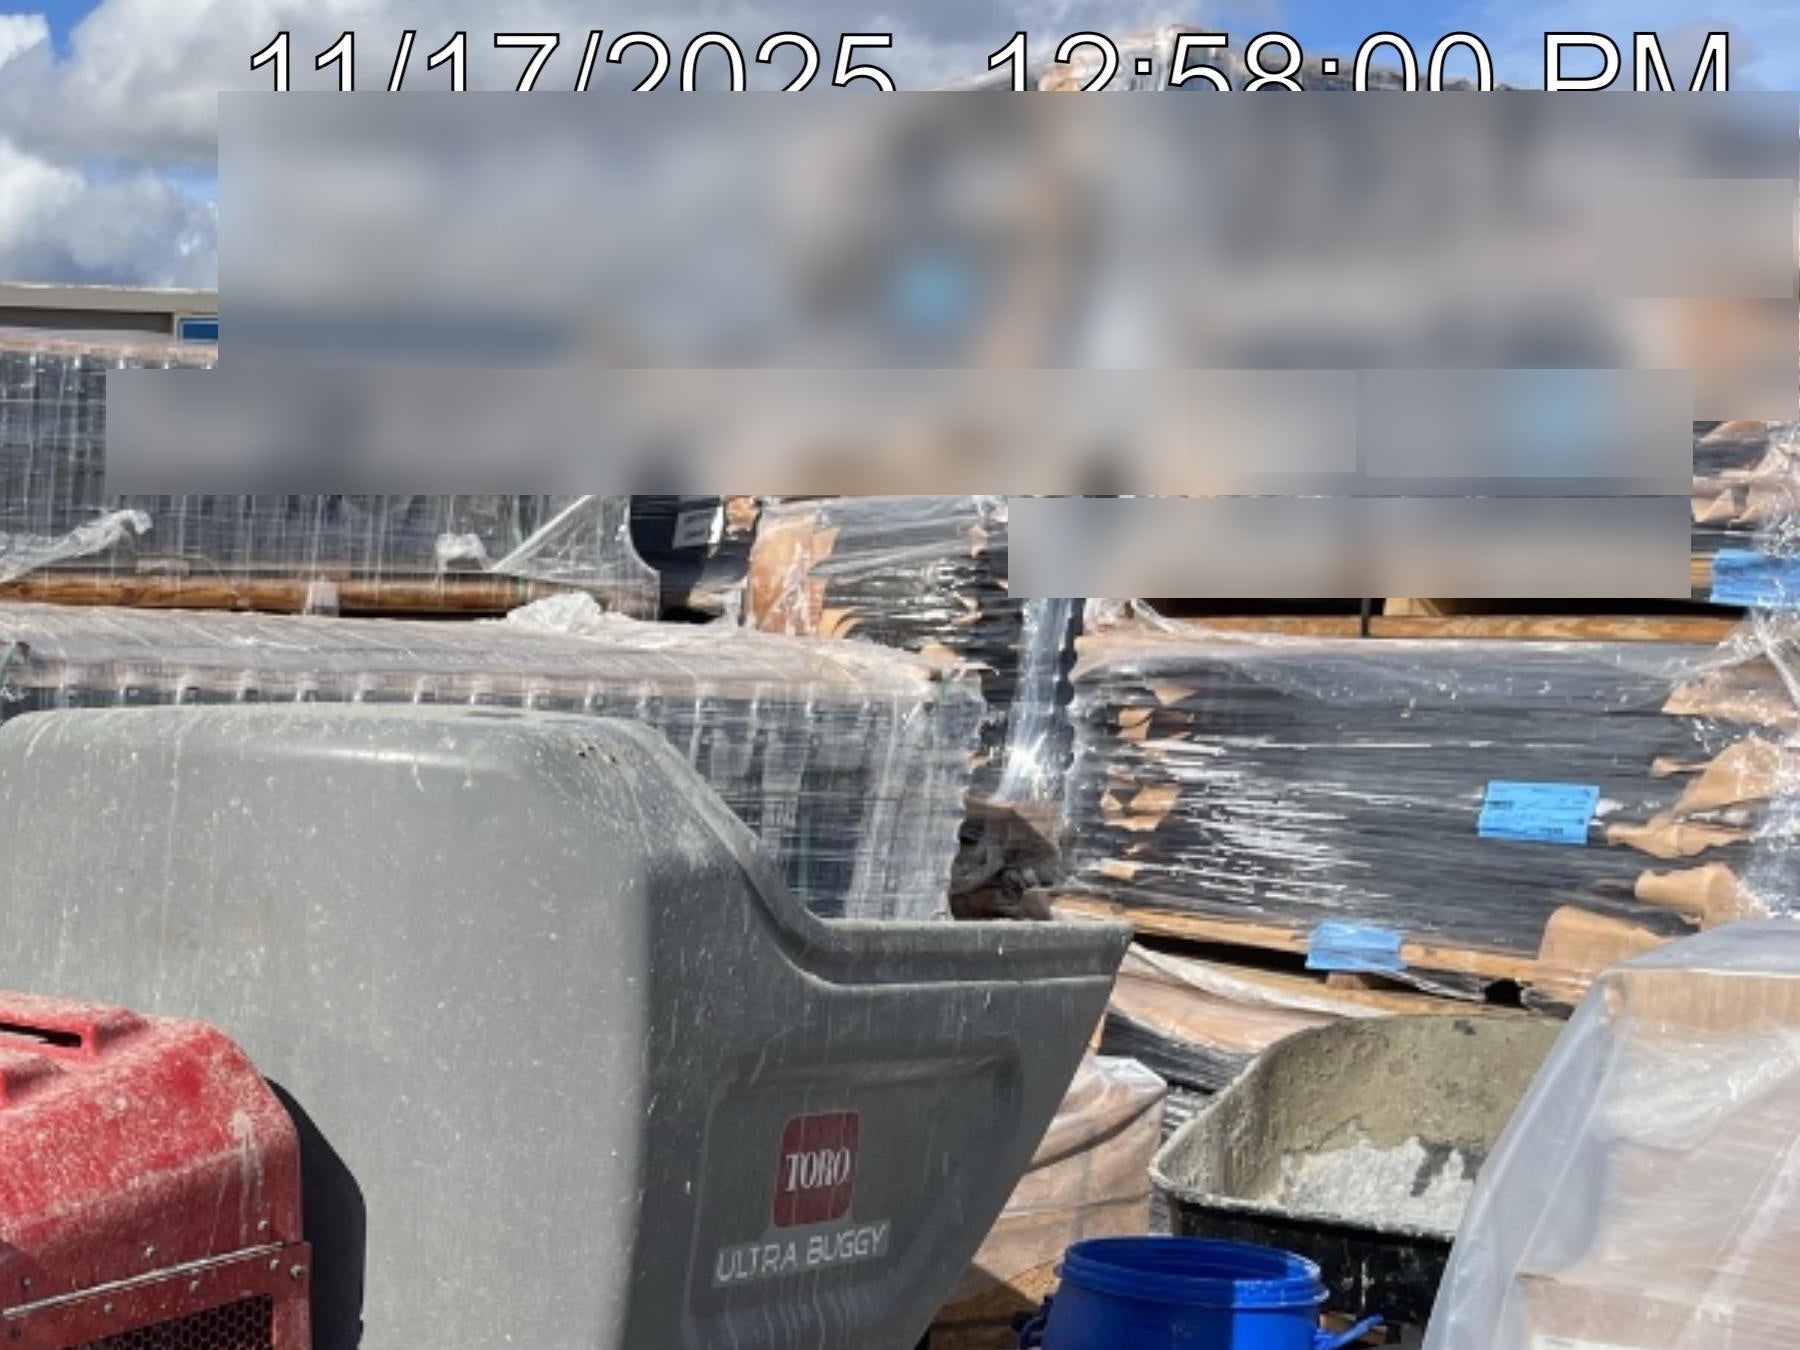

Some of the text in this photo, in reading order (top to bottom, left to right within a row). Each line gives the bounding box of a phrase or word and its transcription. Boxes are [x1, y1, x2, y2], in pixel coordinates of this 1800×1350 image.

[784, 1146, 850, 1192] TORO
[716, 1223, 887, 1282] ULTRA BUGGY
